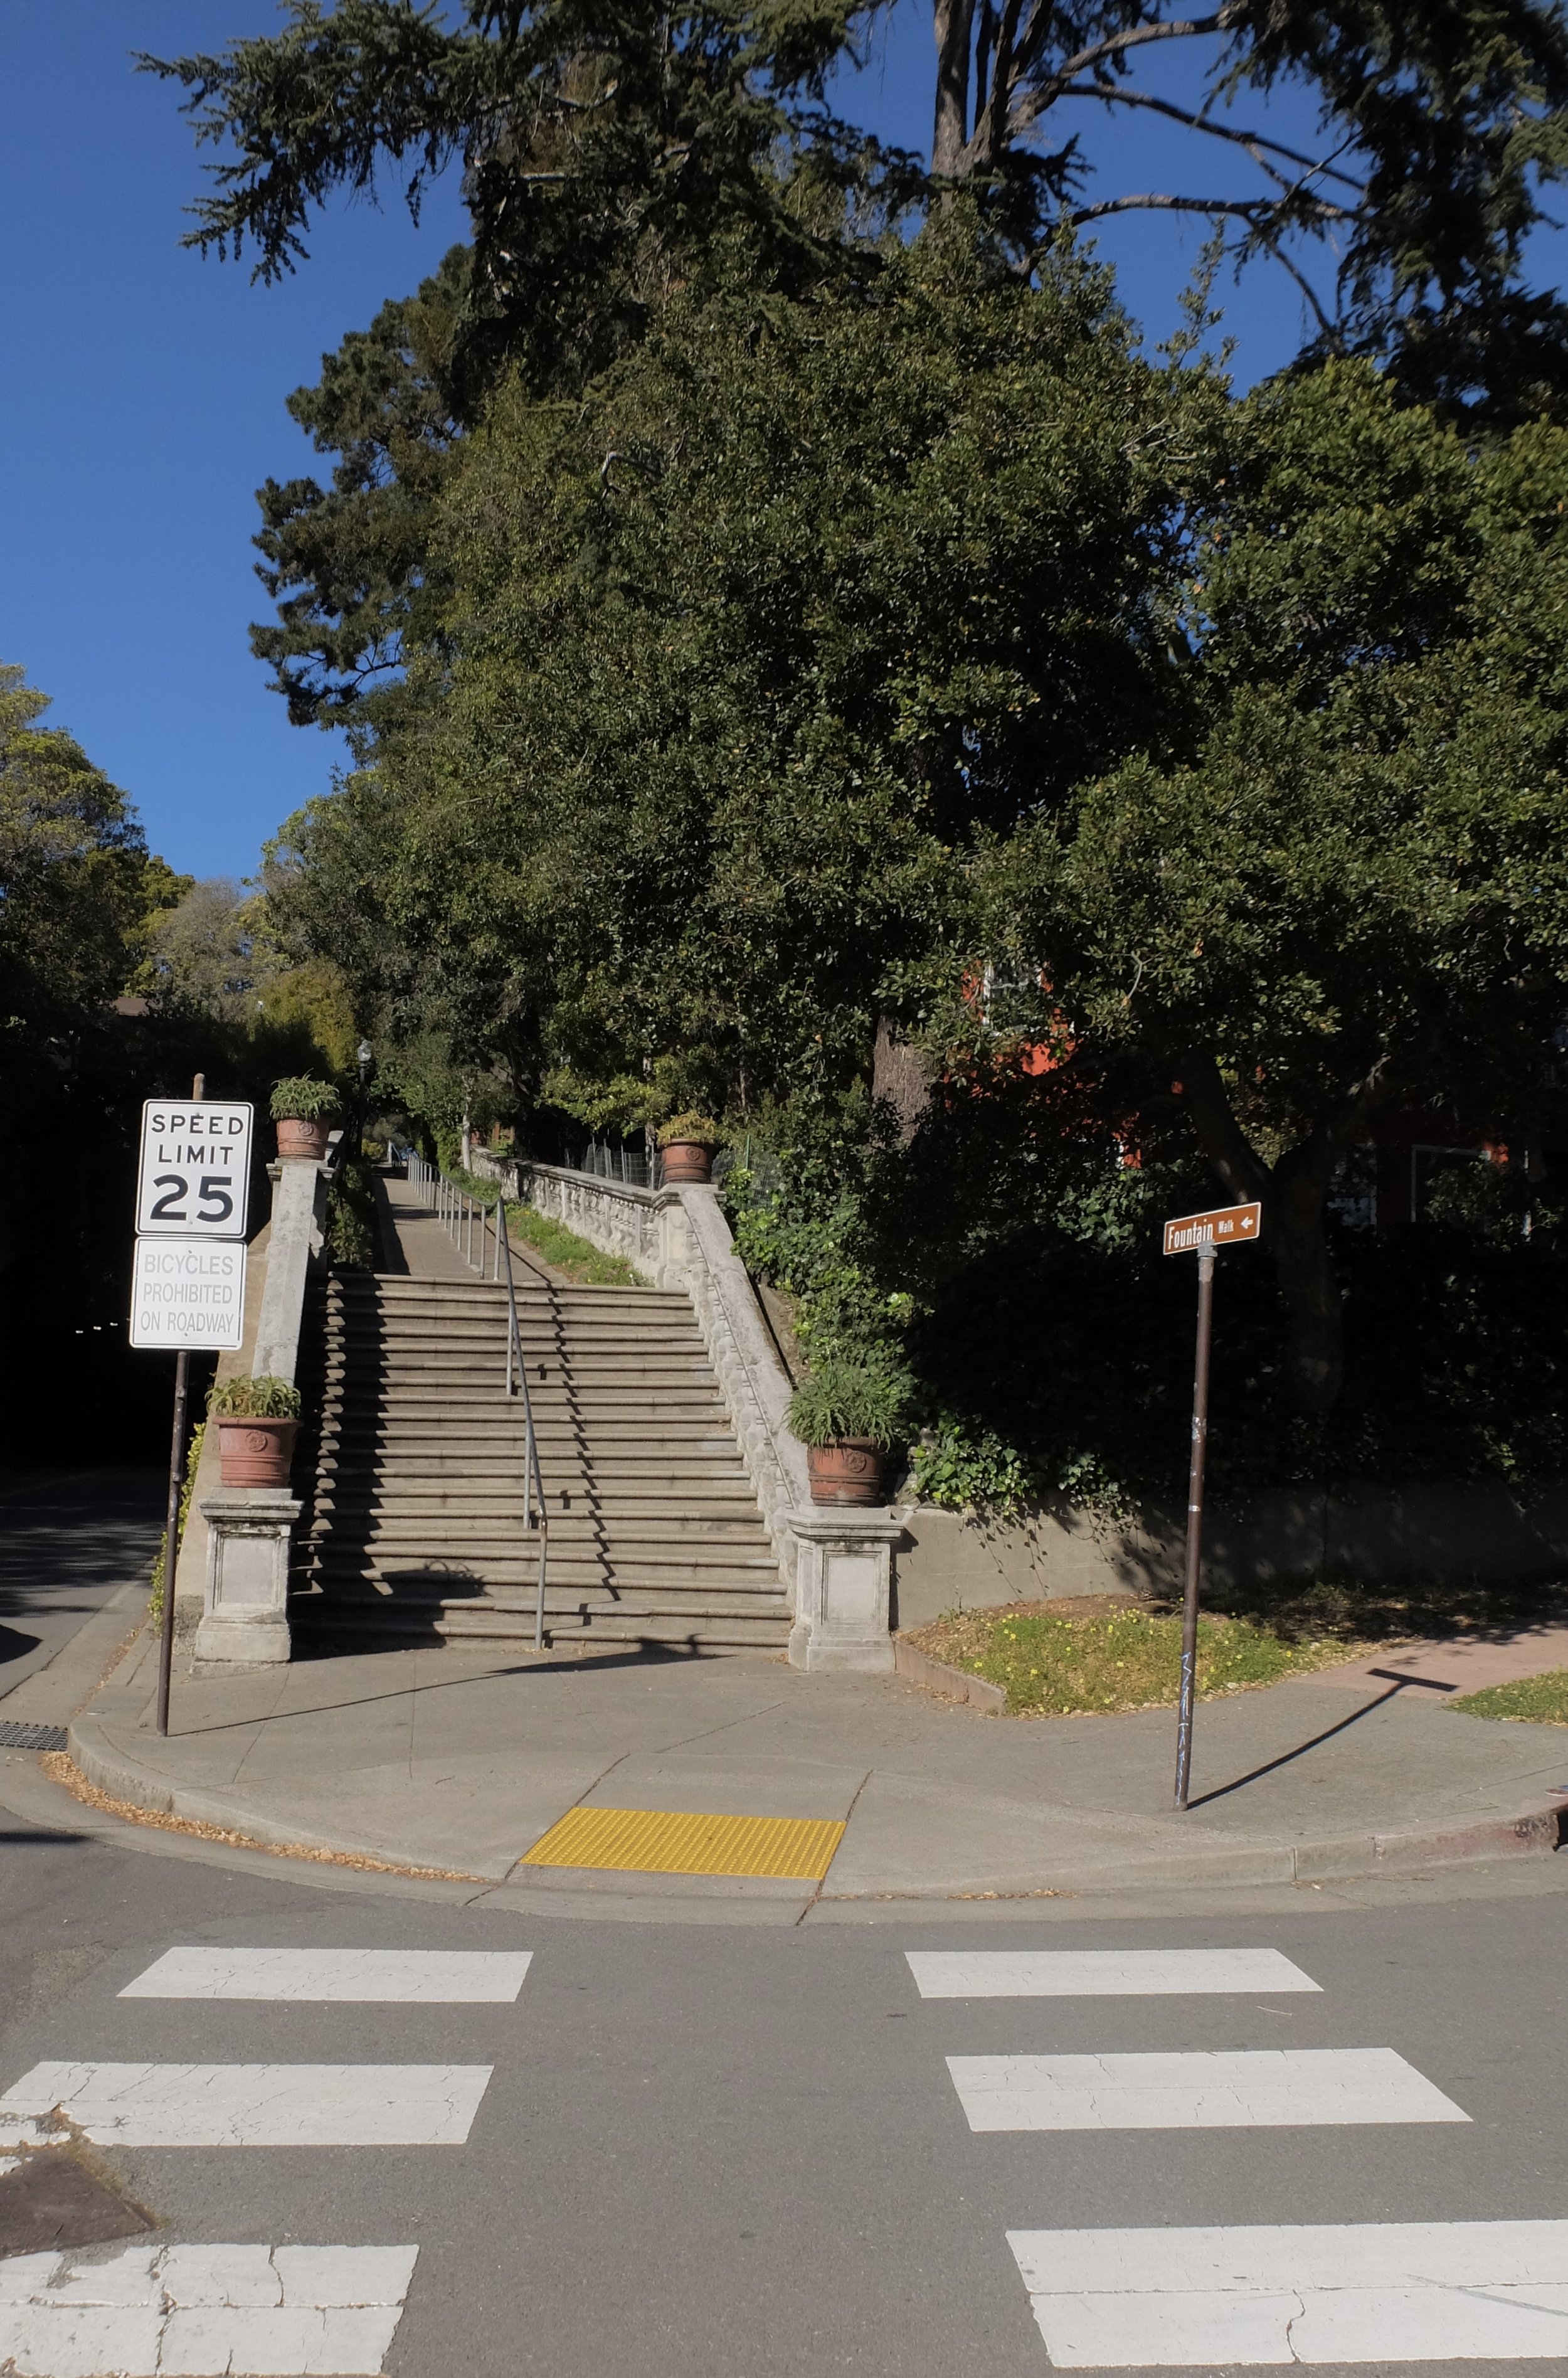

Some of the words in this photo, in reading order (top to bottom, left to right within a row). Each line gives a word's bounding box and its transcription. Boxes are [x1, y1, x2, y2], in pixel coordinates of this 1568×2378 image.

[151, 1114, 244, 1135] SPEED
[158, 1144, 233, 1165] LIMIT
[150, 1174, 233, 1223] 25
[1168, 1218, 1214, 1250] Fountain
[1218, 1219, 1234, 1234] Walk
[144, 1254, 233, 1276] BICYCLES
[143, 1283, 232, 1304] PROHIBITED
[140, 1311, 161, 1331] ON
[167, 1312, 234, 1333] ROADWAY
